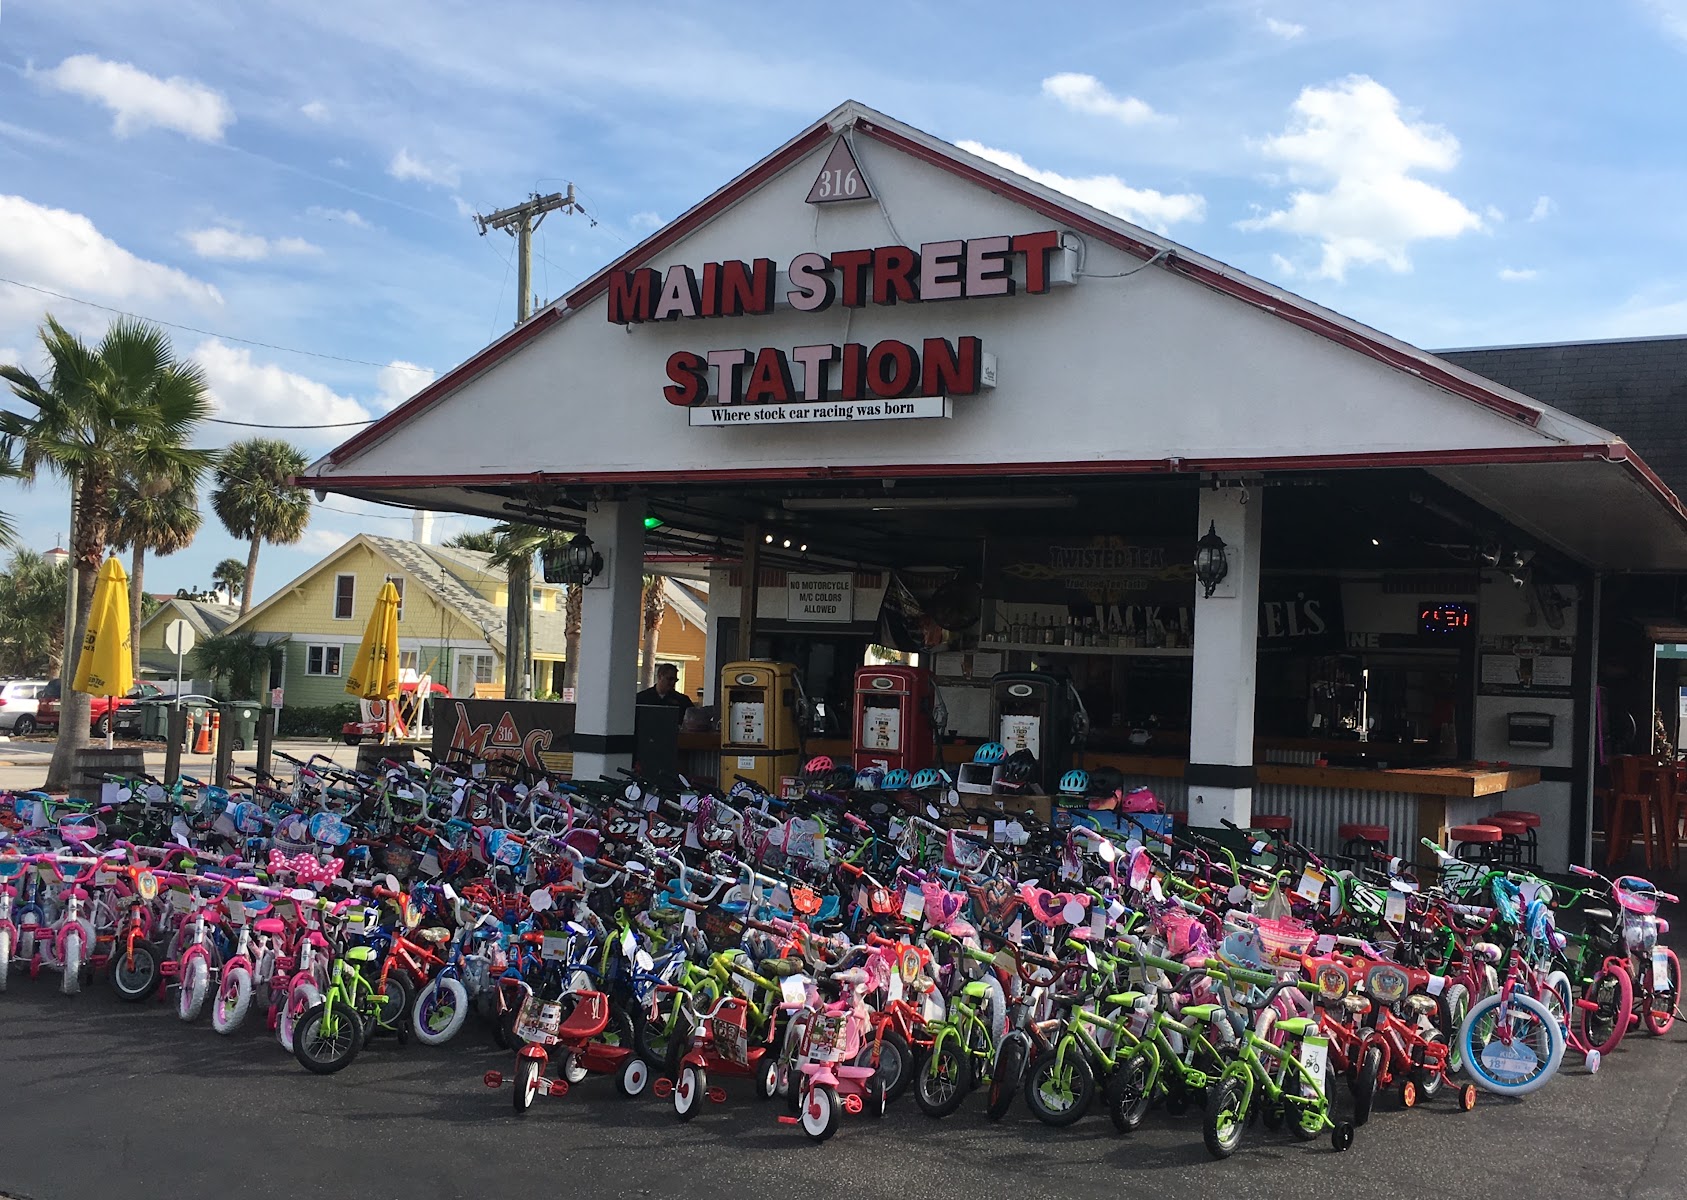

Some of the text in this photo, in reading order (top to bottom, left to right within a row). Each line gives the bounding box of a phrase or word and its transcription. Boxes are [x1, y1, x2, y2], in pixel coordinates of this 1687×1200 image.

[819, 167, 857, 198] 316
[608, 231, 1061, 325] MAIN STREET
[663, 336, 981, 406] STATION
[711, 402, 915, 422] Where stock car racing was born
[790, 581, 849, 590] NO MOTORCYCLE
[799, 593, 842, 602] M/C COLORS
[804, 605, 837, 614] ALLOWED
[498, 726, 514, 742] 316
